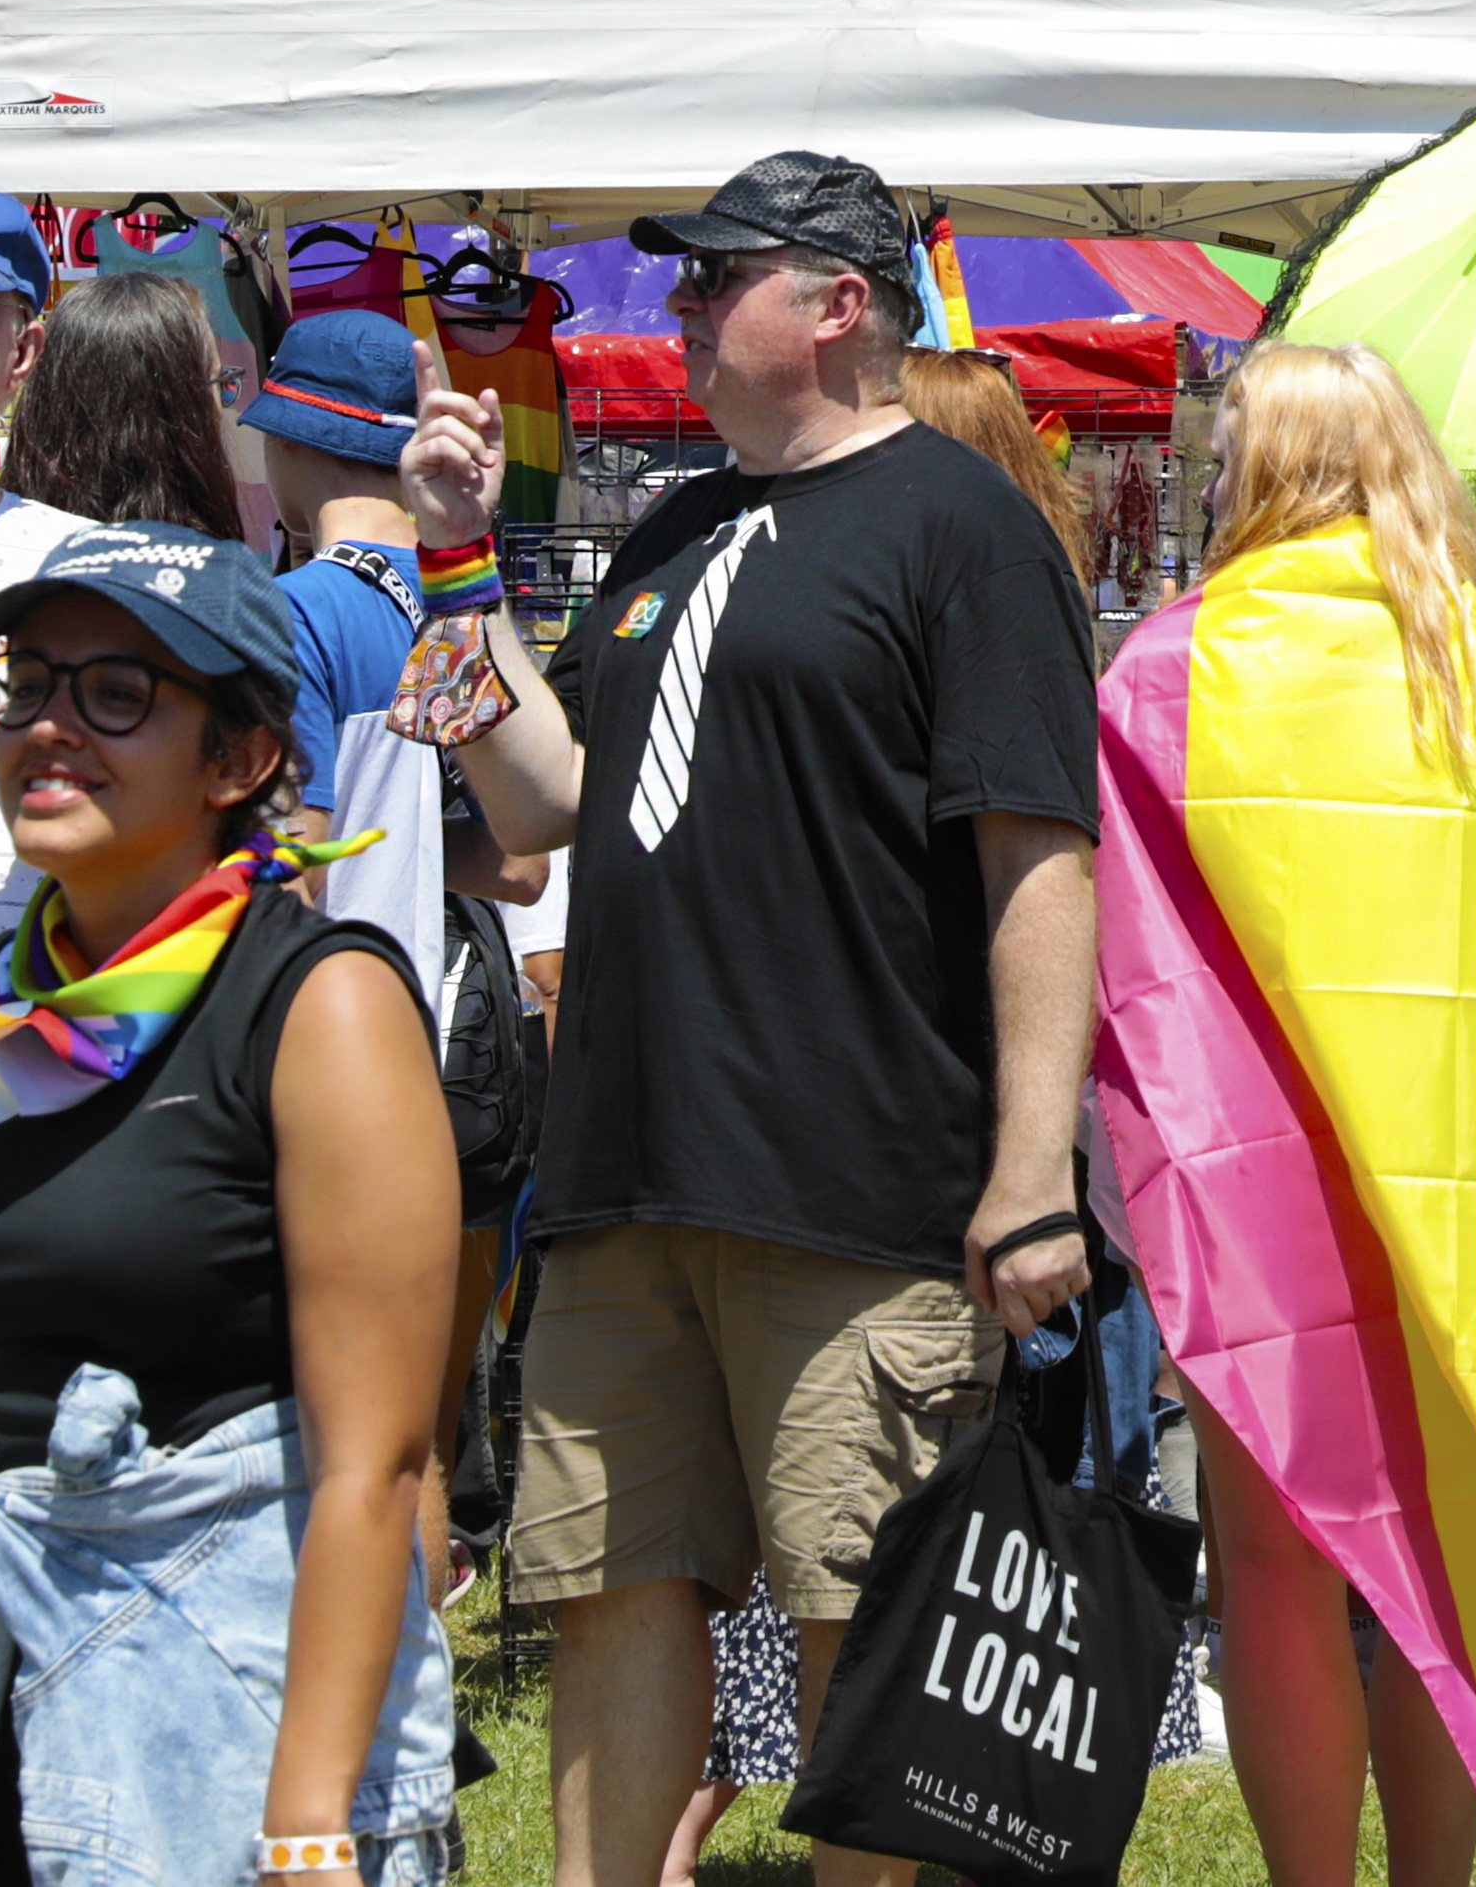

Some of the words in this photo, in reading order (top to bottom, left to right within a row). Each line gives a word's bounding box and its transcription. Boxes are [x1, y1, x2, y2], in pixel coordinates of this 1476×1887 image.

[44, 104, 105, 115] MARQUEES
[954, 1510, 1080, 1654] LOVE
[924, 1613, 1098, 1774] LOCAL
[905, 1766, 979, 1813] HILLS
[984, 1803, 999, 1826] &
[1006, 1812, 1072, 1860] WEST
[913, 1799, 974, 1833] HANDMADE
[977, 1828, 990, 1841] IN
[992, 1837, 1046, 1872] AUSTRALIA
